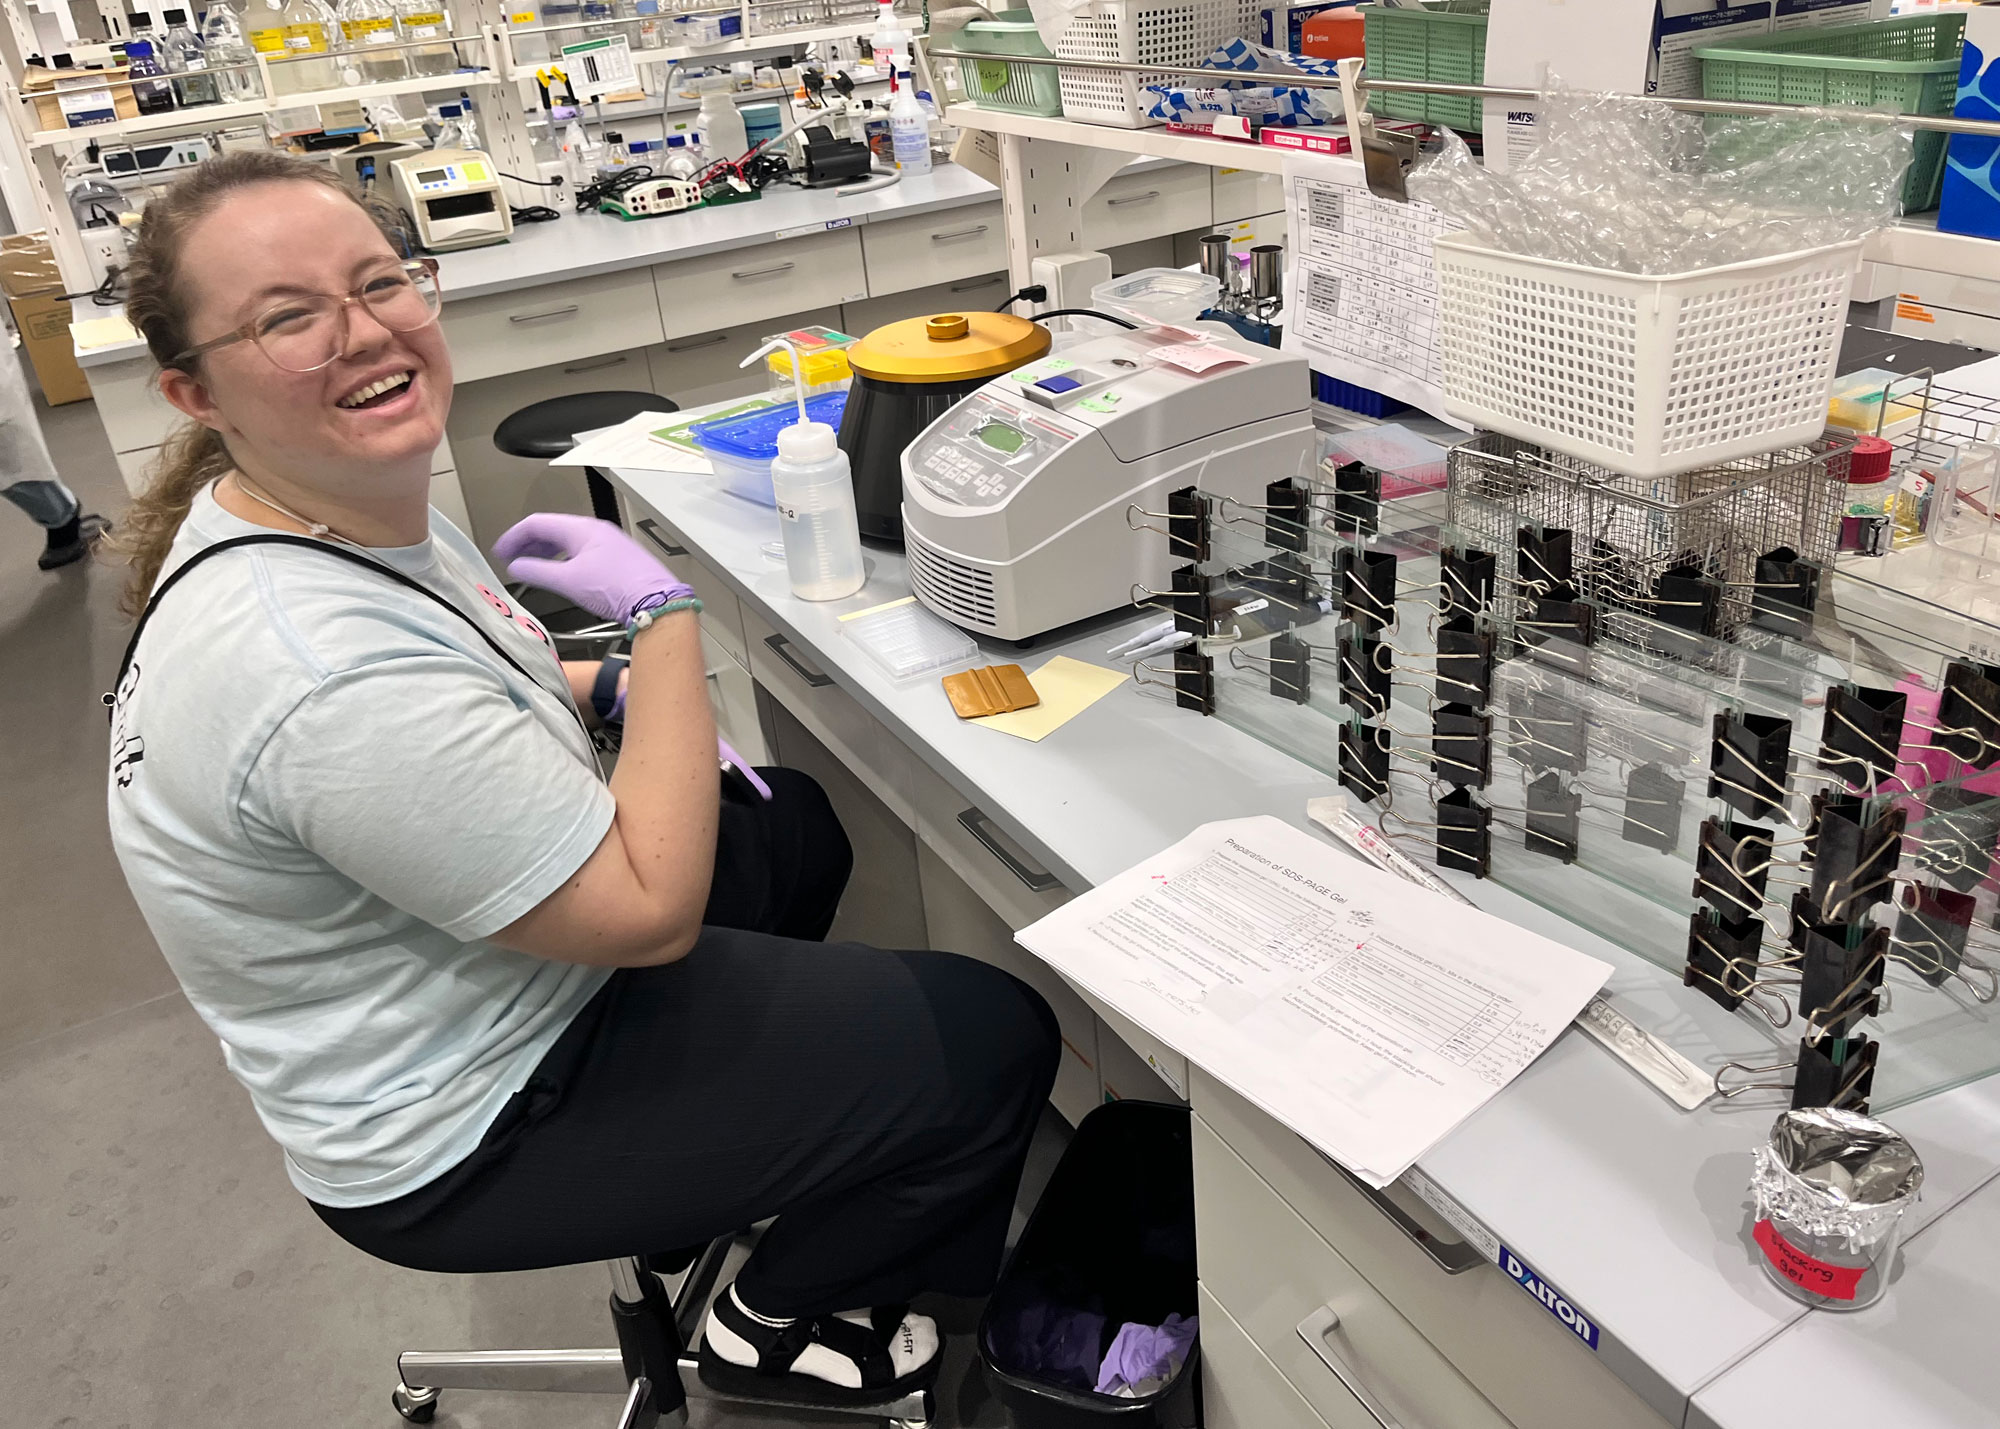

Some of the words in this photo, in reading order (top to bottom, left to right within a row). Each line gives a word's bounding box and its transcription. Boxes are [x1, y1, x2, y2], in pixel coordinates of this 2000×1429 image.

[1224, 838, 1272, 866] Preparation
[1282, 868, 1331, 896] SDS-PAGE
[1330, 893, 1348, 904] Gel
[1507, 1254, 1591, 1341] DALTON
